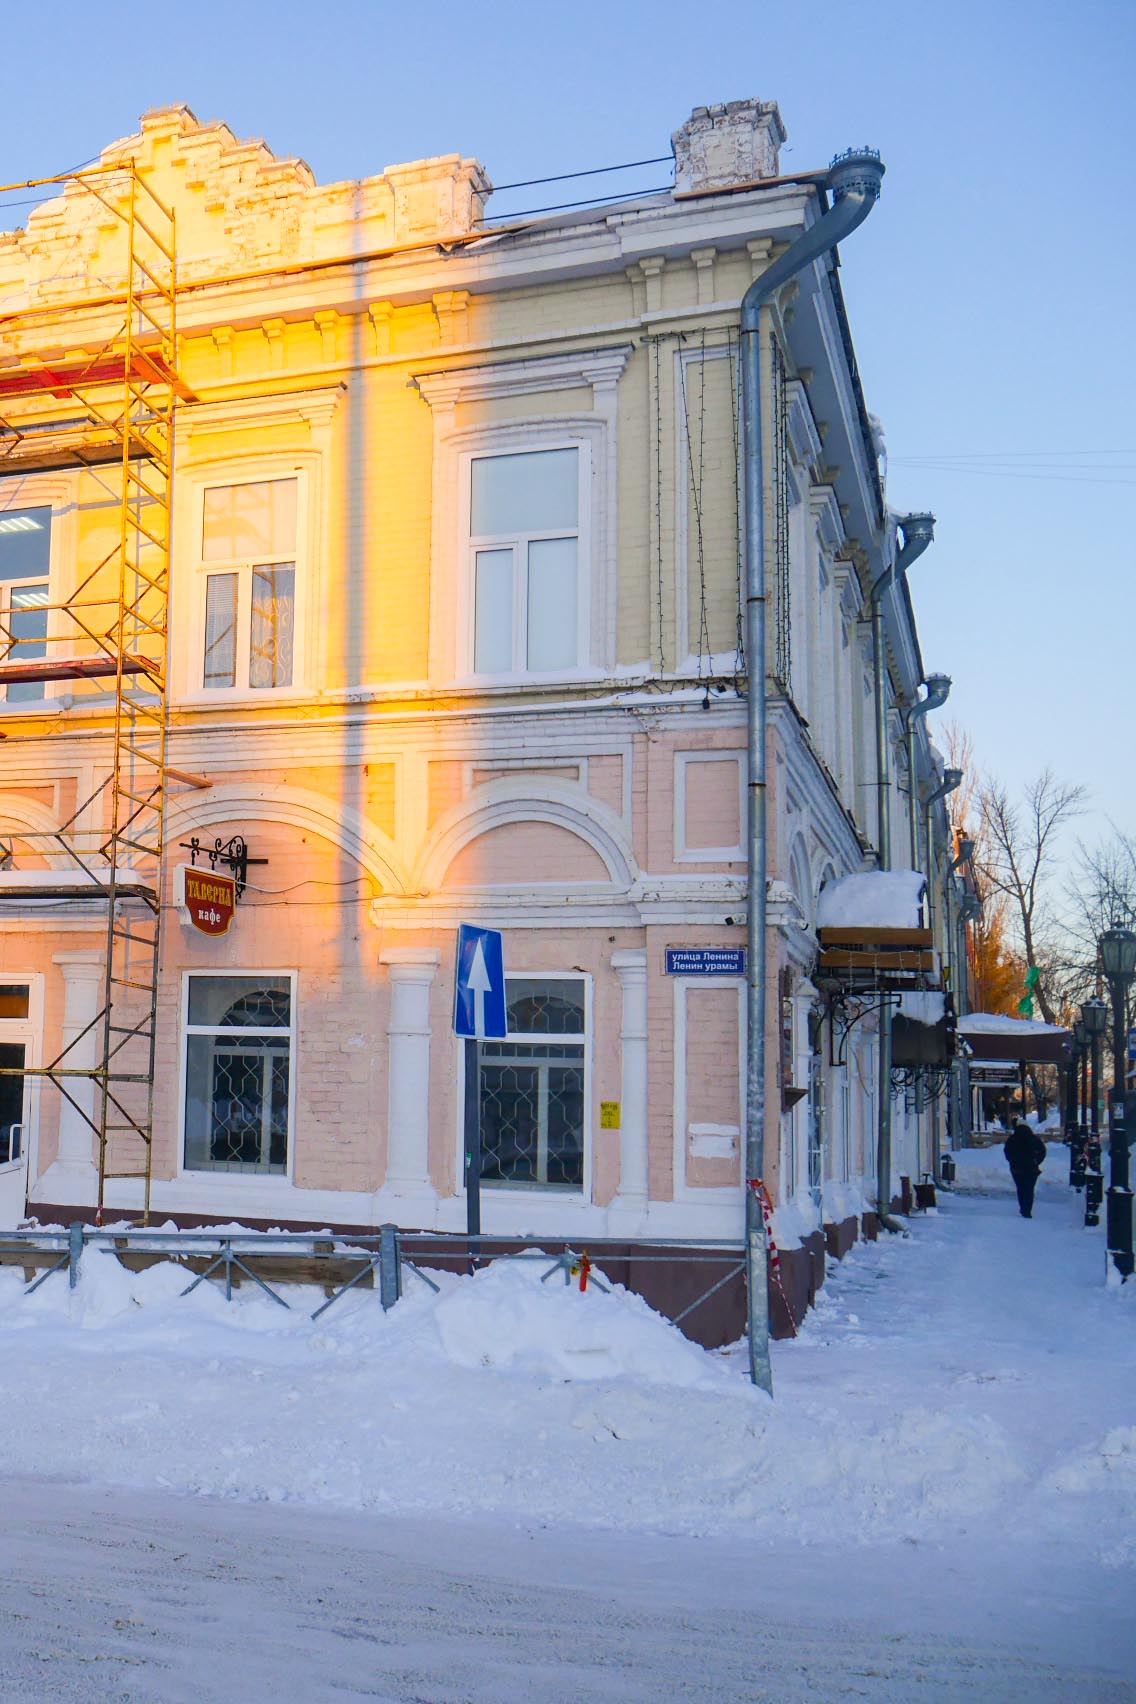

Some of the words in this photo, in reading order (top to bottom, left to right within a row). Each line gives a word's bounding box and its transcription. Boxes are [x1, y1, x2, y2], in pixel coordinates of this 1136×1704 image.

[188, 880, 232, 907] ТАВЕРНА
[198, 908, 221, 925] кафе
[672, 953, 701, 962] улица
[703, 952, 739, 961] Ленина
[673, 962, 703, 970] Ленин
[705, 963, 738, 971] урамы
